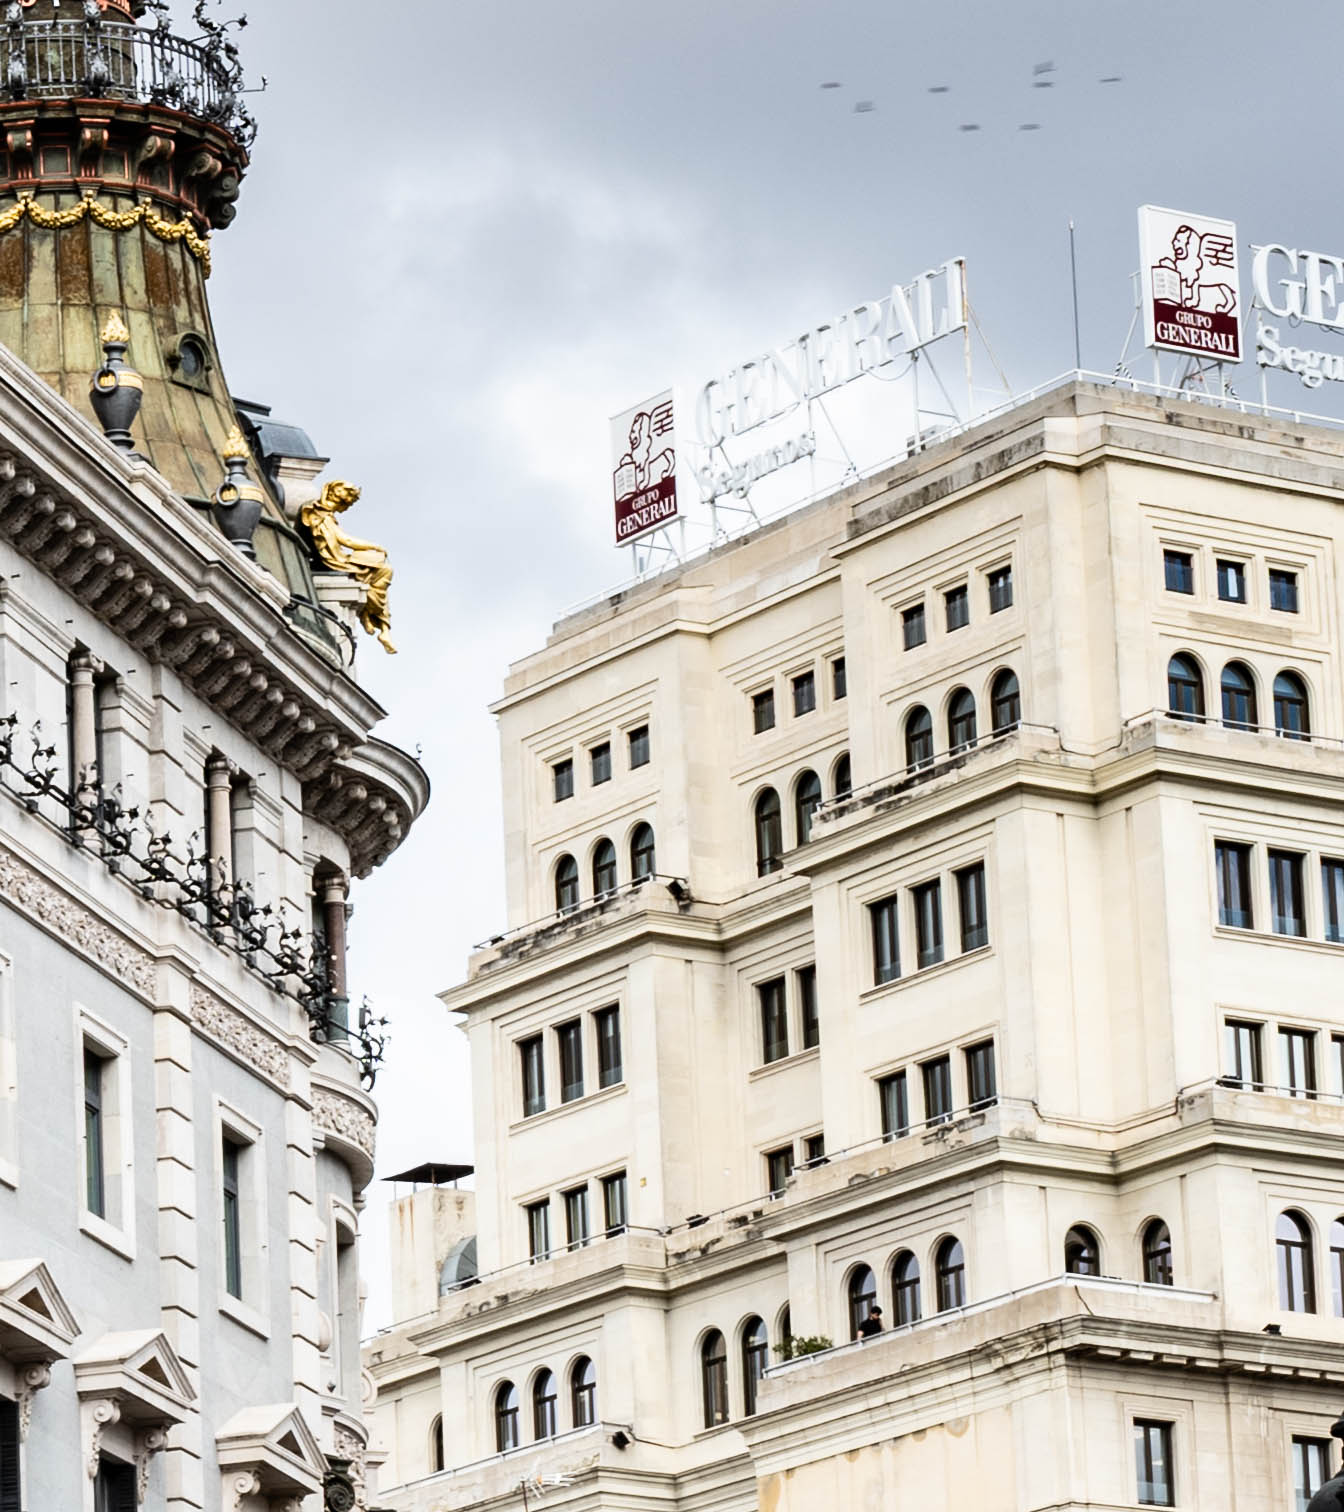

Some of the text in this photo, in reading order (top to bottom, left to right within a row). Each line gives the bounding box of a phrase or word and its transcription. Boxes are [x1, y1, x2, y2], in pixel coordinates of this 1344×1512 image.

[1175, 310, 1212, 329] GRUPO
[695, 255, 966, 448] GENERALI
[1156, 321, 1236, 354] GENERALI
[631, 488, 661, 512] GRUPO
[616, 497, 678, 538] GENERALI
